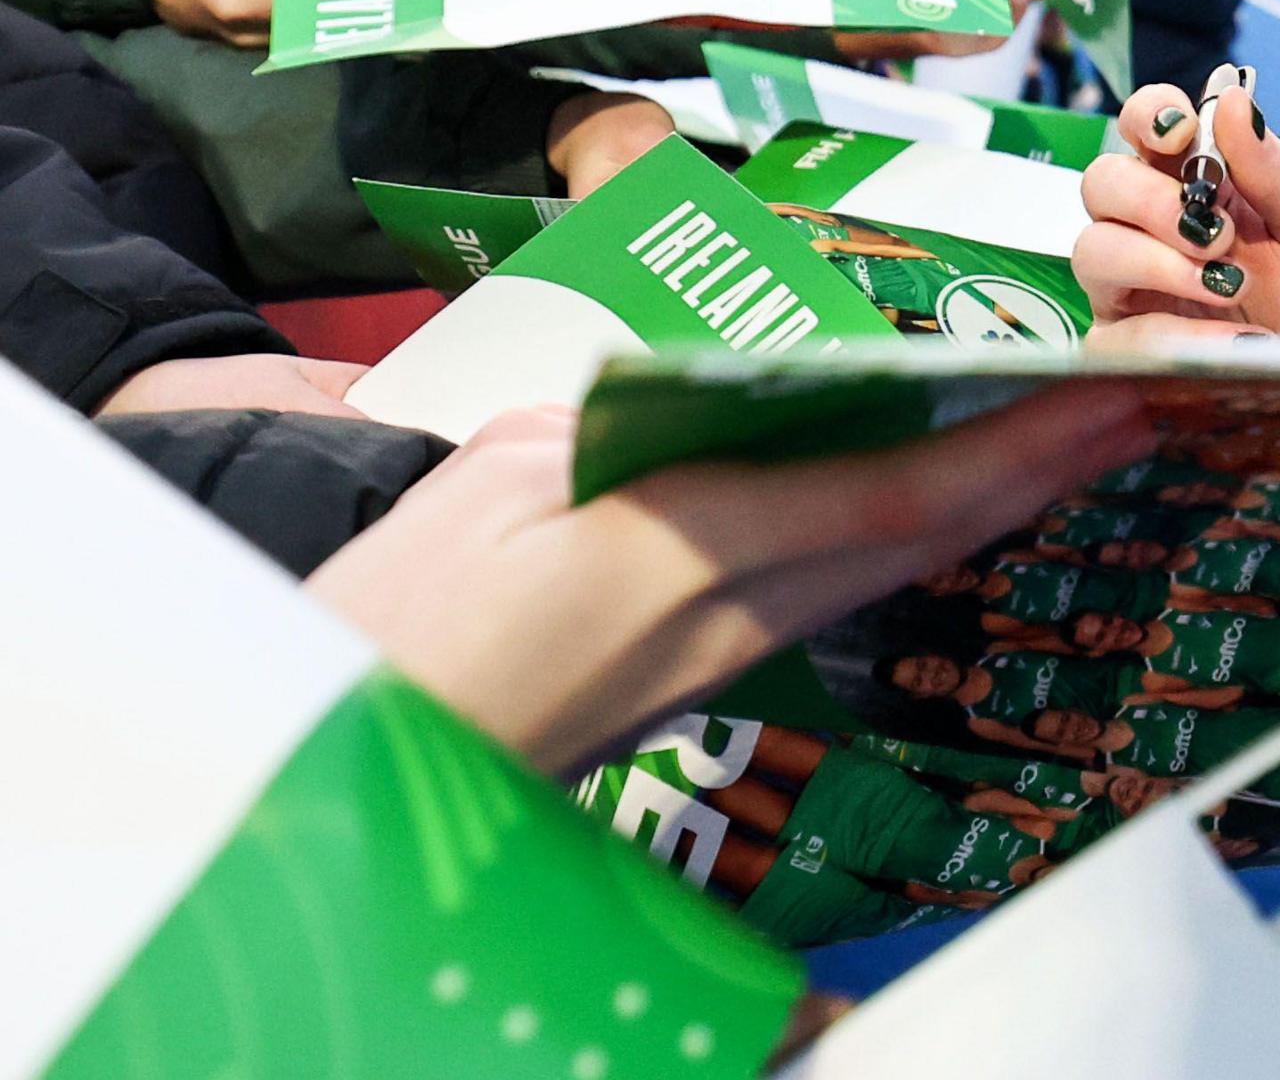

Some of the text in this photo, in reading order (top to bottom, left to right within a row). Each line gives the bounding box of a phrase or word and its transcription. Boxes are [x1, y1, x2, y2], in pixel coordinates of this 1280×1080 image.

[626, 199, 819, 356] IRELAND
[1169, 709, 1199, 773] SoftCo
[936, 817, 990, 883] SoftCo
